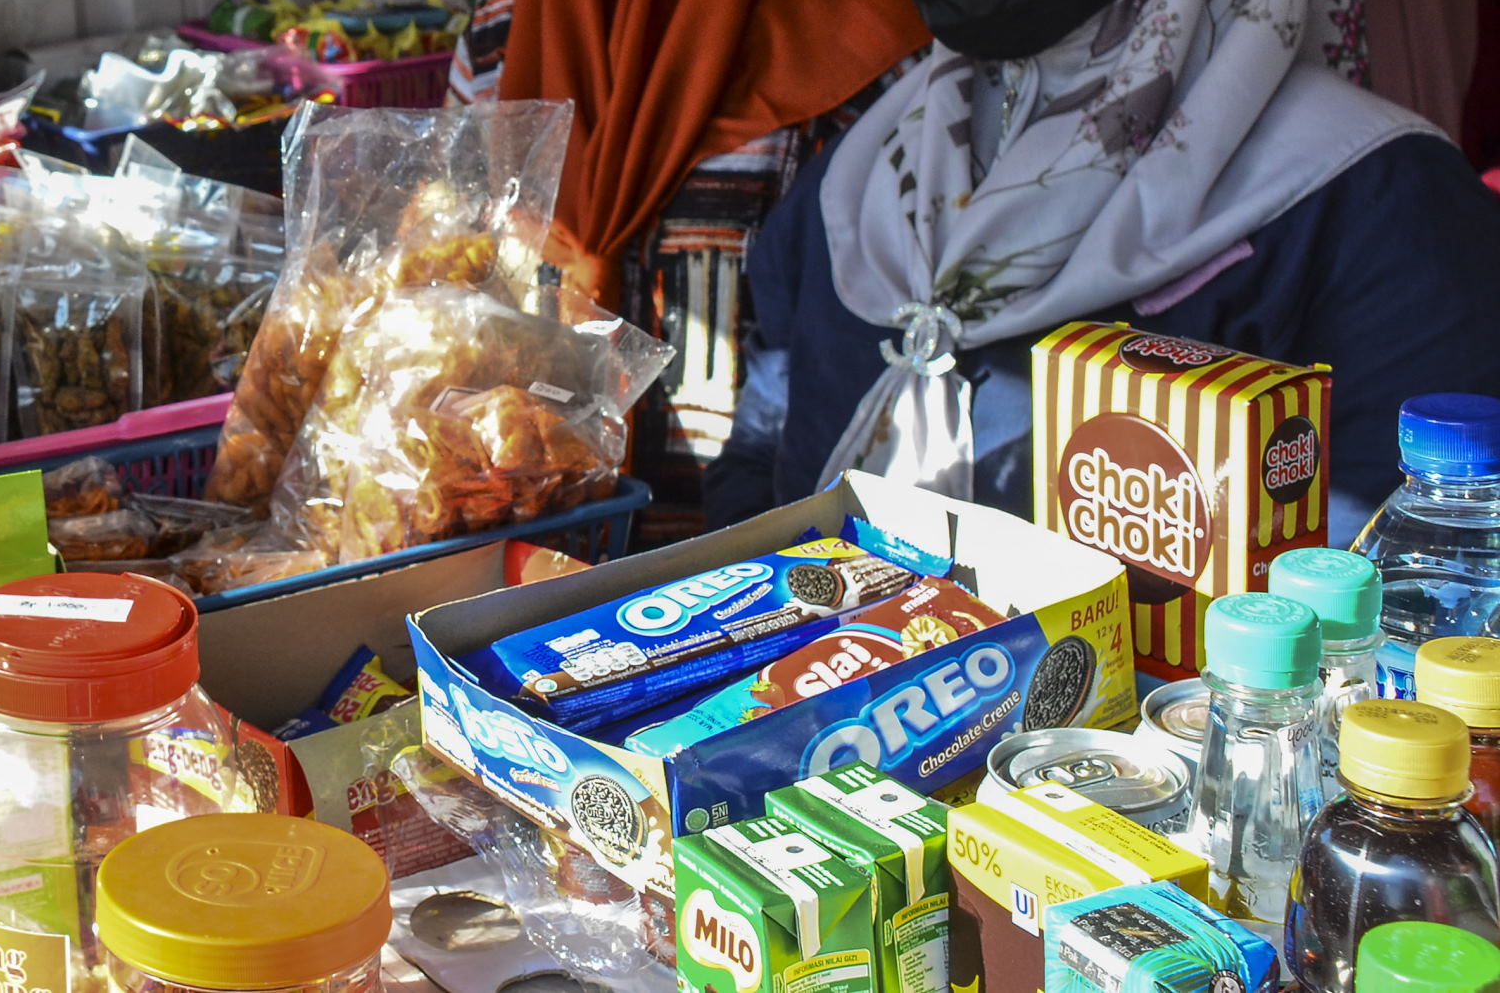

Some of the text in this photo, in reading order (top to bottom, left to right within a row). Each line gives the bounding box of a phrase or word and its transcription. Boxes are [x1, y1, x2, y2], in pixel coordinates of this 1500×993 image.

[1265, 429, 1316, 467] choki
[1265, 456, 1316, 490] choki
[1069, 448, 1197, 526] choki
[1069, 498, 1196, 578] choki
[624, 562, 768, 631] OREO
[1069, 589, 1120, 632] BARU!
[809, 646, 1011, 776] OREO
[918, 690, 1021, 777] Chocolate Creme
[711, 805, 729, 819] SNI
[954, 828, 1003, 879] 50%
[694, 907, 755, 974] MILO
